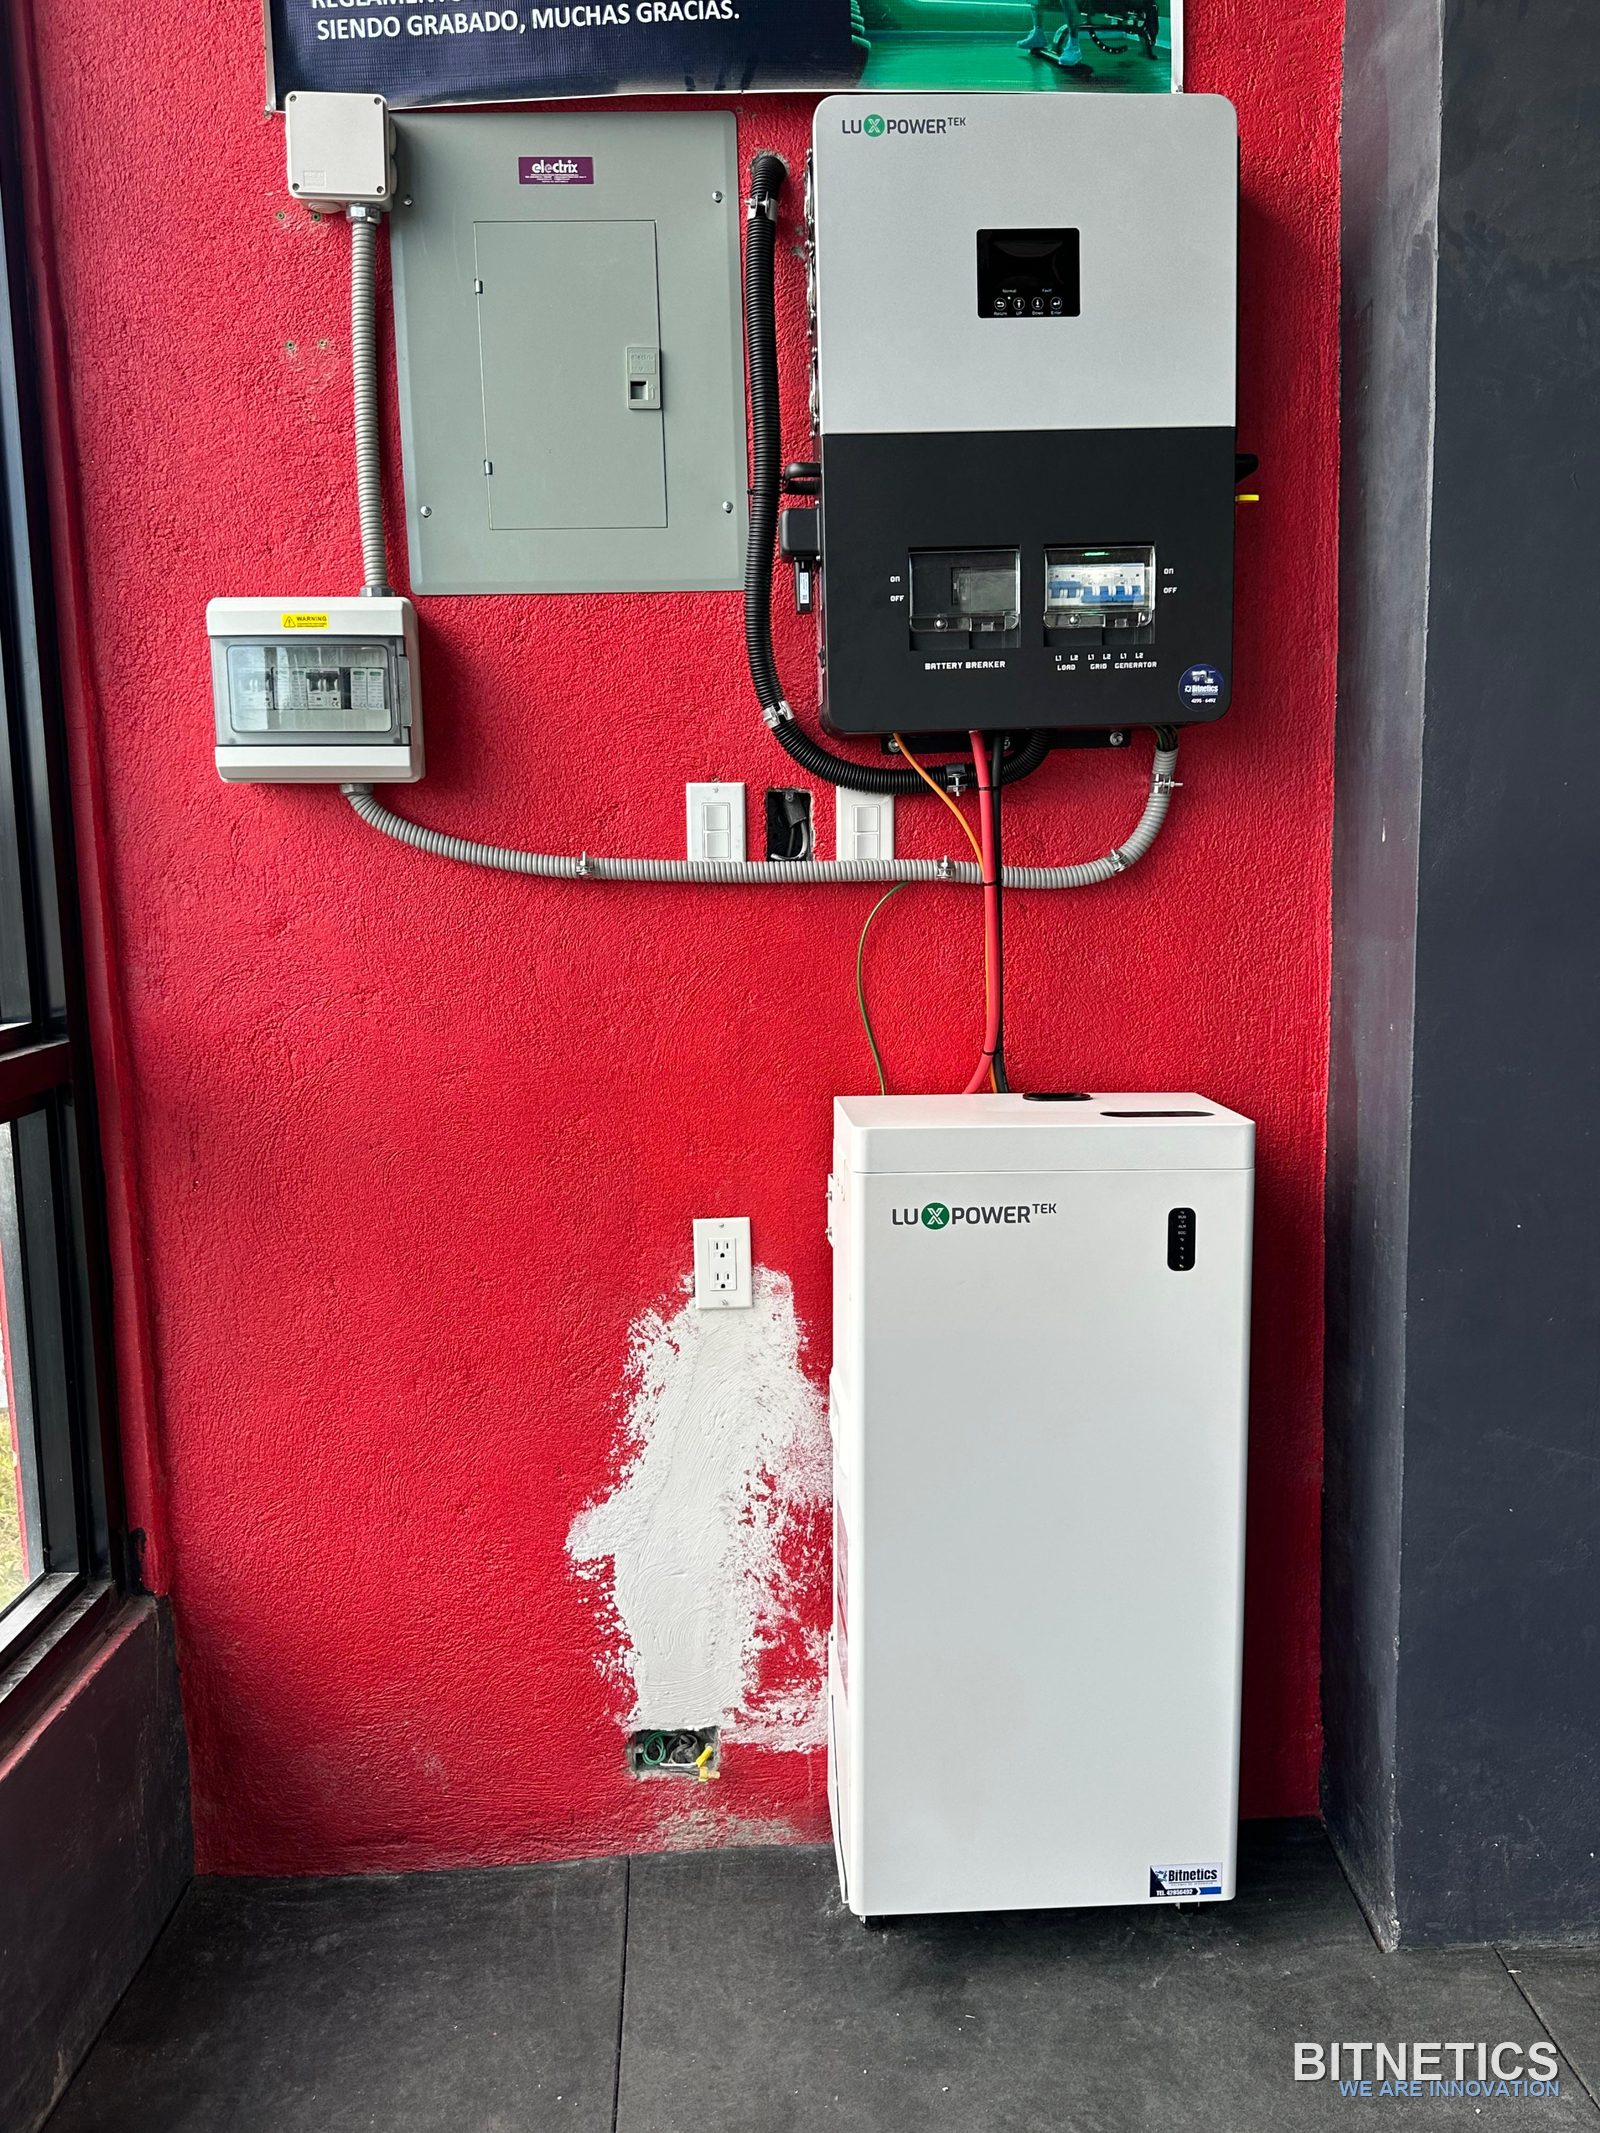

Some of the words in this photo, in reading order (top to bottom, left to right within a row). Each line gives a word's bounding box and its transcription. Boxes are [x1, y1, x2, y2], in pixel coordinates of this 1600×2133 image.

[317, 16, 400, 40] SIENDO
[407, 10, 526, 36] GRABADO,
[532, 3, 631, 29] MUCHAS
[636, 0, 740, 22] GRACIAS.
[531, 160, 578, 173] electrix
[1163, 586, 1178, 594] OFF
[890, 594, 905, 602] OFF
[1055, 654, 1062, 662] L1
[1087, 653, 1095, 661] L1
[1120, 652, 1127, 660] L1
[924, 661, 963, 671] BATTERY
[965, 660, 1006, 670] BREAKER
[1114, 661, 1157, 669] GENERATOR
[1168, 1868, 1218, 1882] Bitnetics
